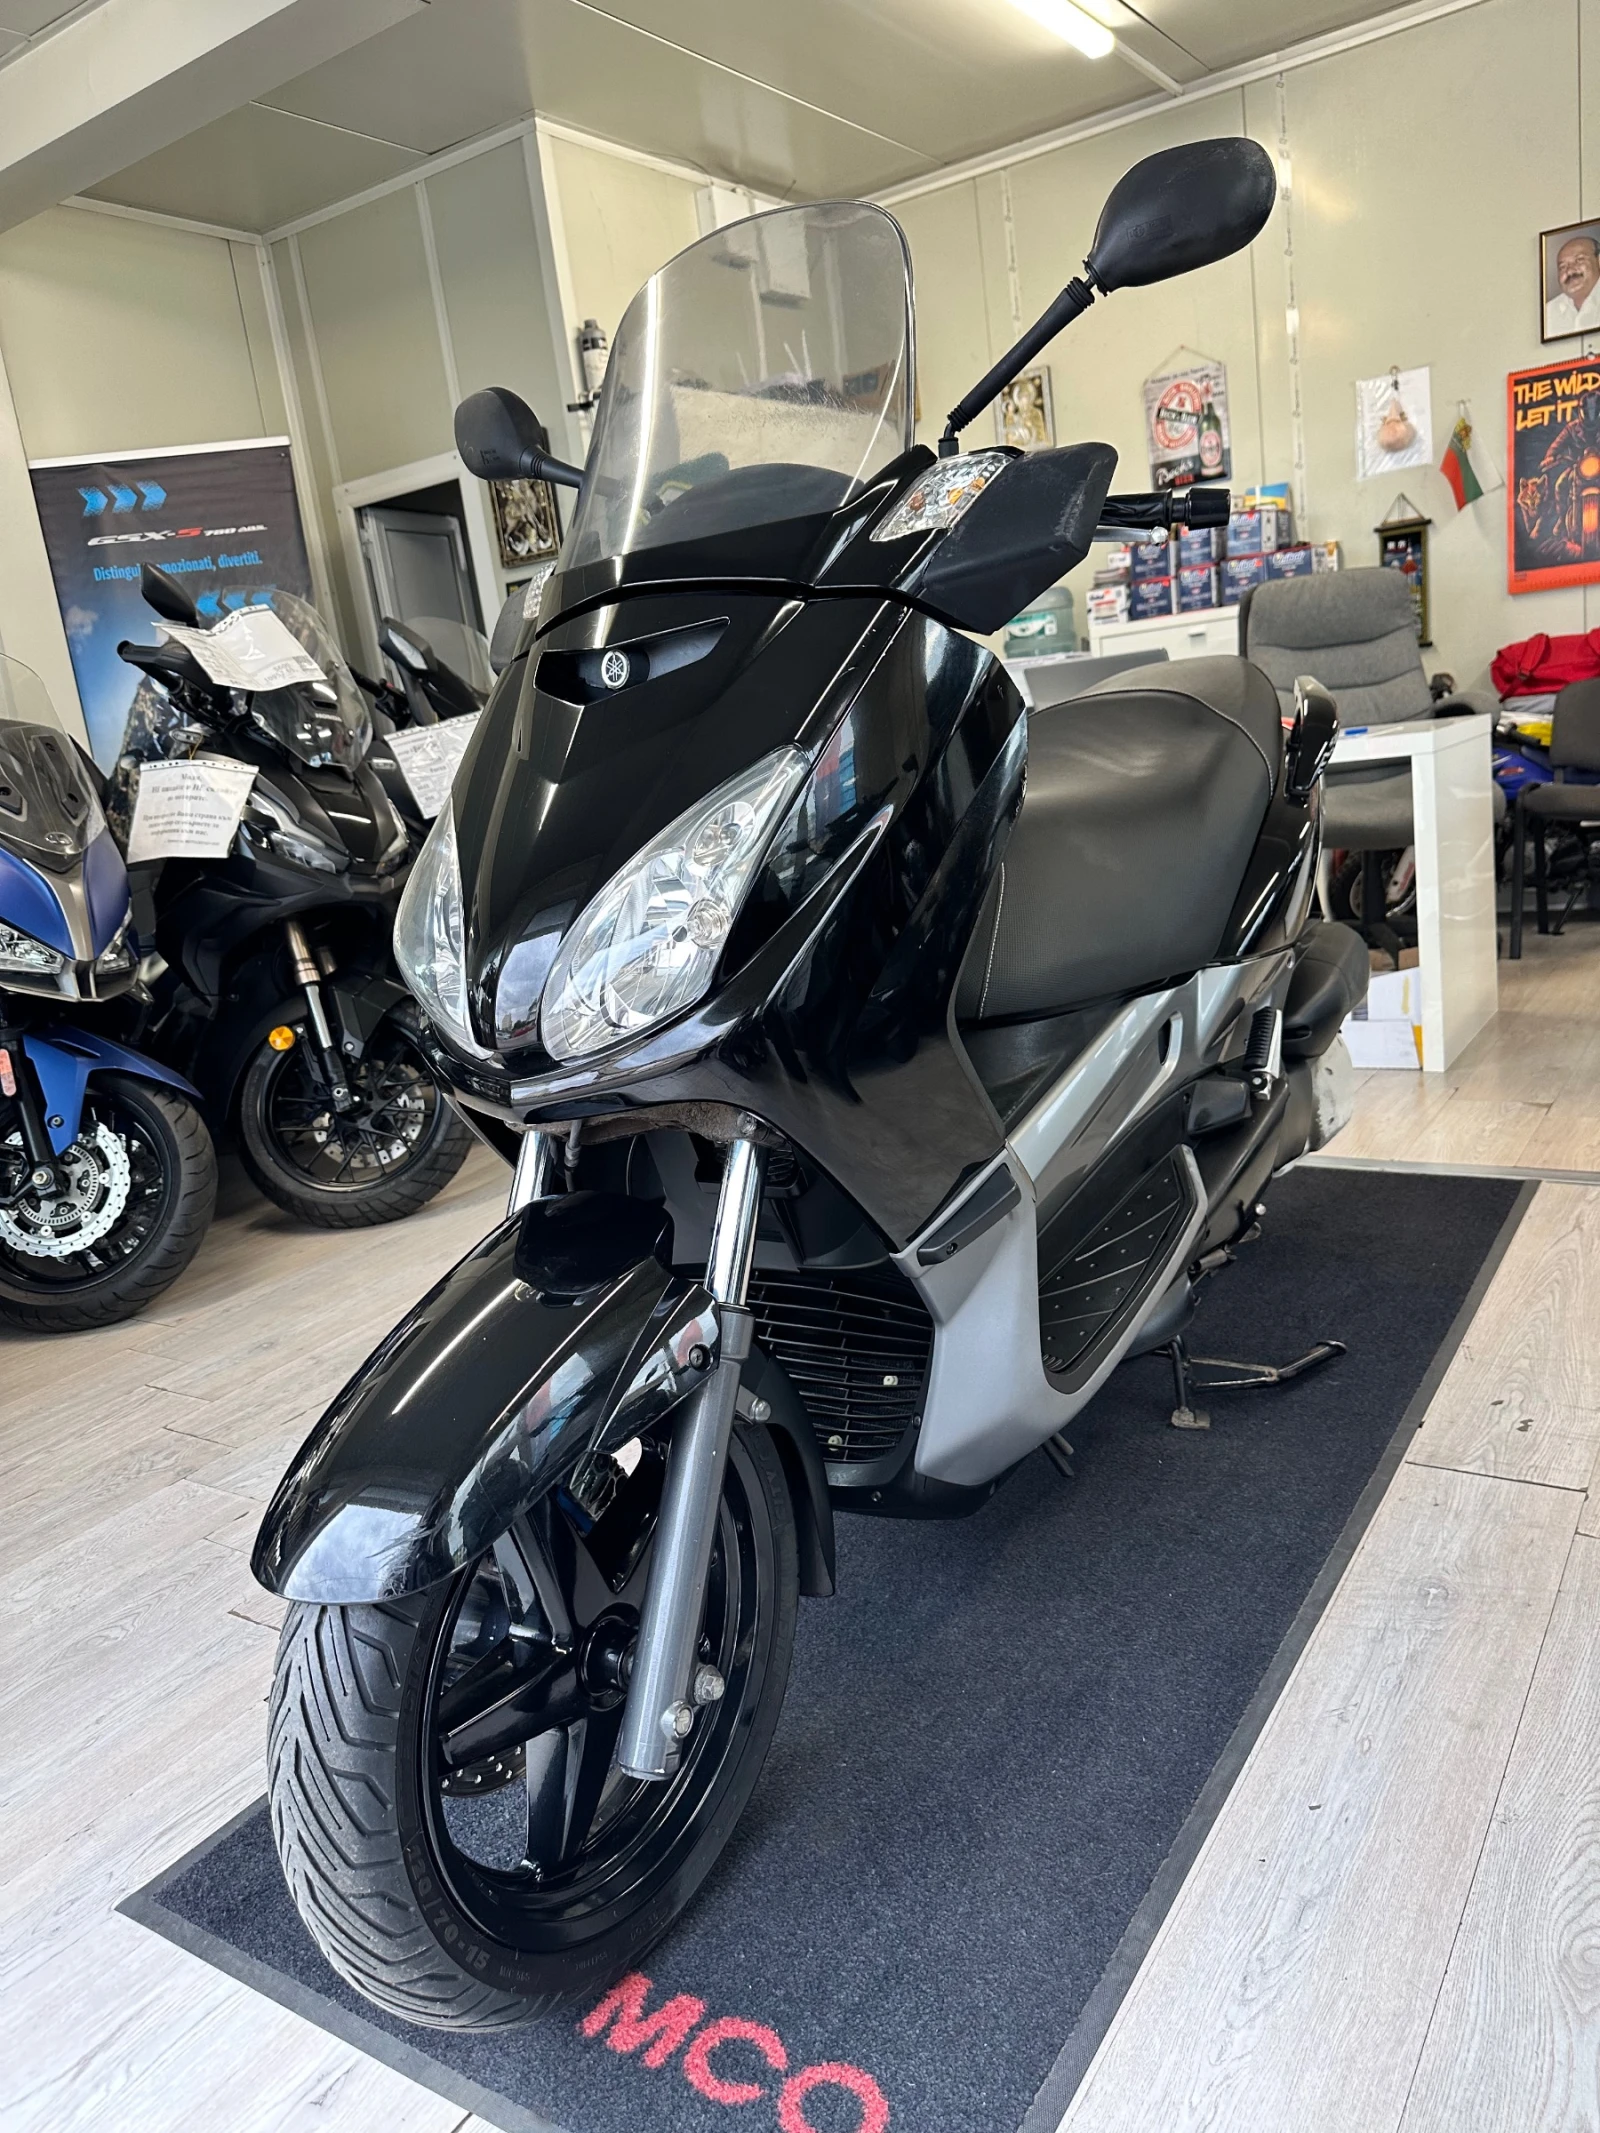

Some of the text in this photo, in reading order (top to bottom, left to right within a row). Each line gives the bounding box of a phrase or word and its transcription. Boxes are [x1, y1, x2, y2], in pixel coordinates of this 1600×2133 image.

[1513, 380, 1553, 404] THE
[1516, 400, 1579, 431] LET IT
[93, 563, 141, 582] Distingui
[217, 550, 263, 569] divertiti.
